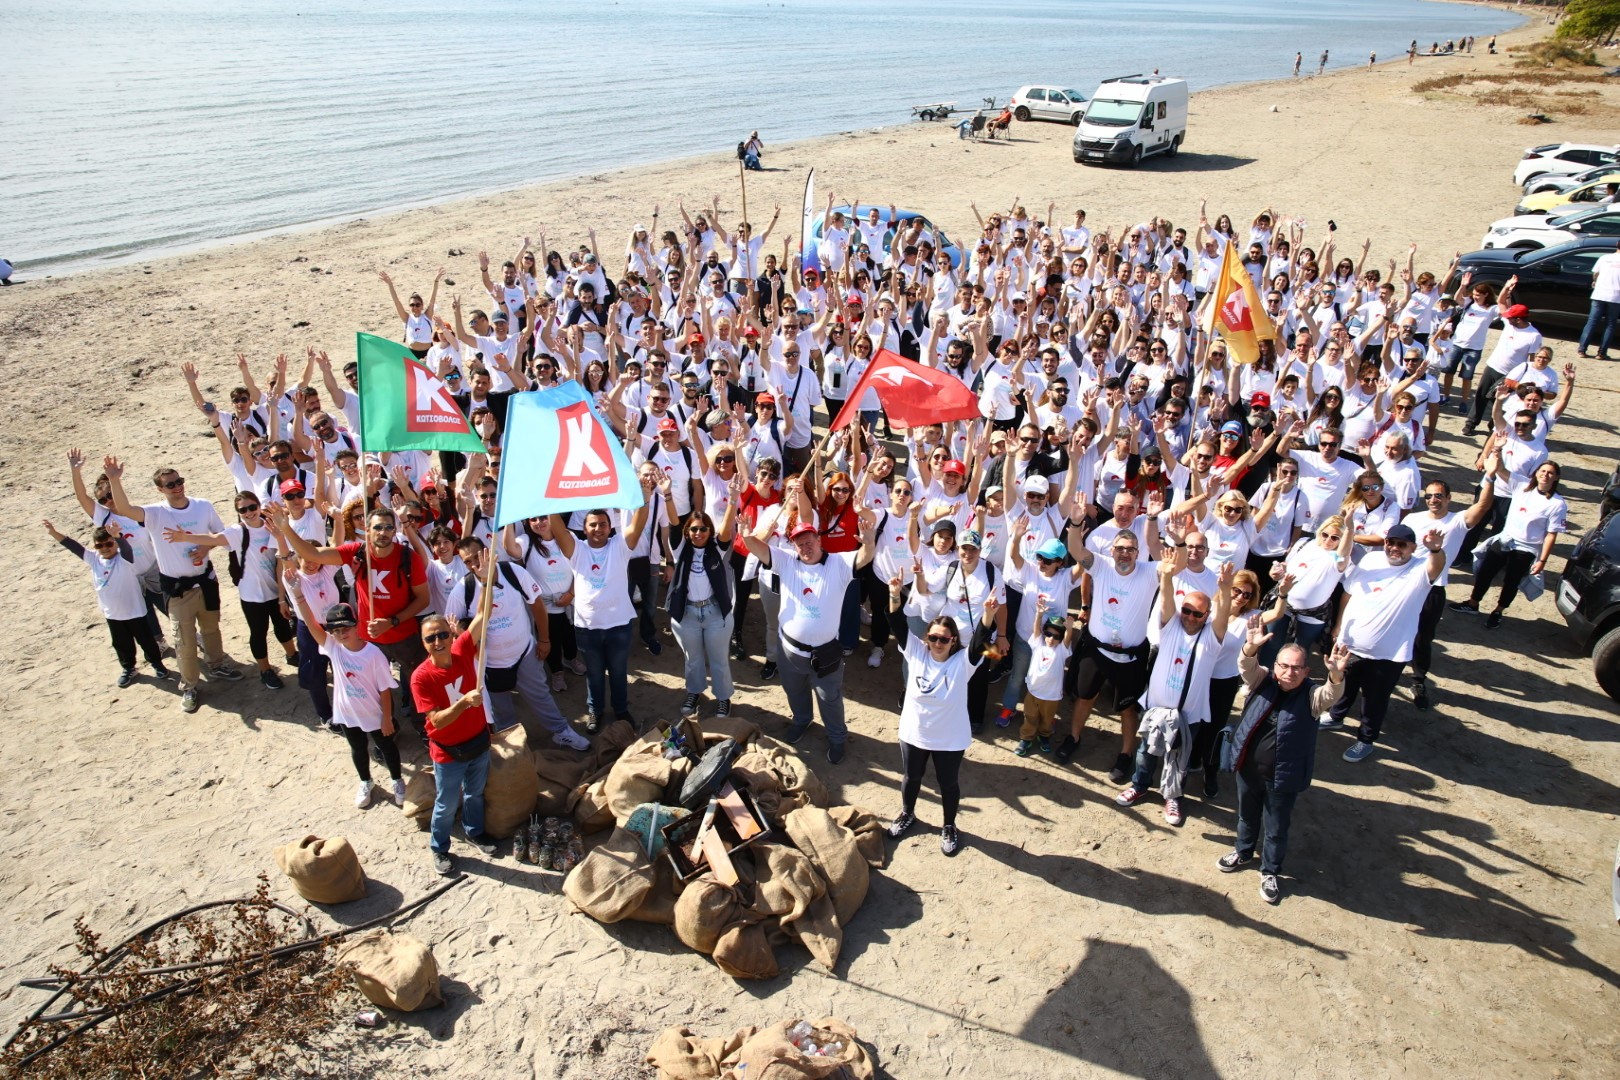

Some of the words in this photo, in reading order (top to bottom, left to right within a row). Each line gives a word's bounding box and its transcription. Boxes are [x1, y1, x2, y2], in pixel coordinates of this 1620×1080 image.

[413, 366, 459, 415] Κ
[416, 415, 461, 425] ΚΩΤΣΟΒΟΛΟΣ
[562, 411, 609, 476] Κ
[558, 476, 611, 489] ΚΩΤΣΟΒΟΛΟΣ
[372, 569, 391, 594] Κ
[444, 676, 464, 706] Κ
